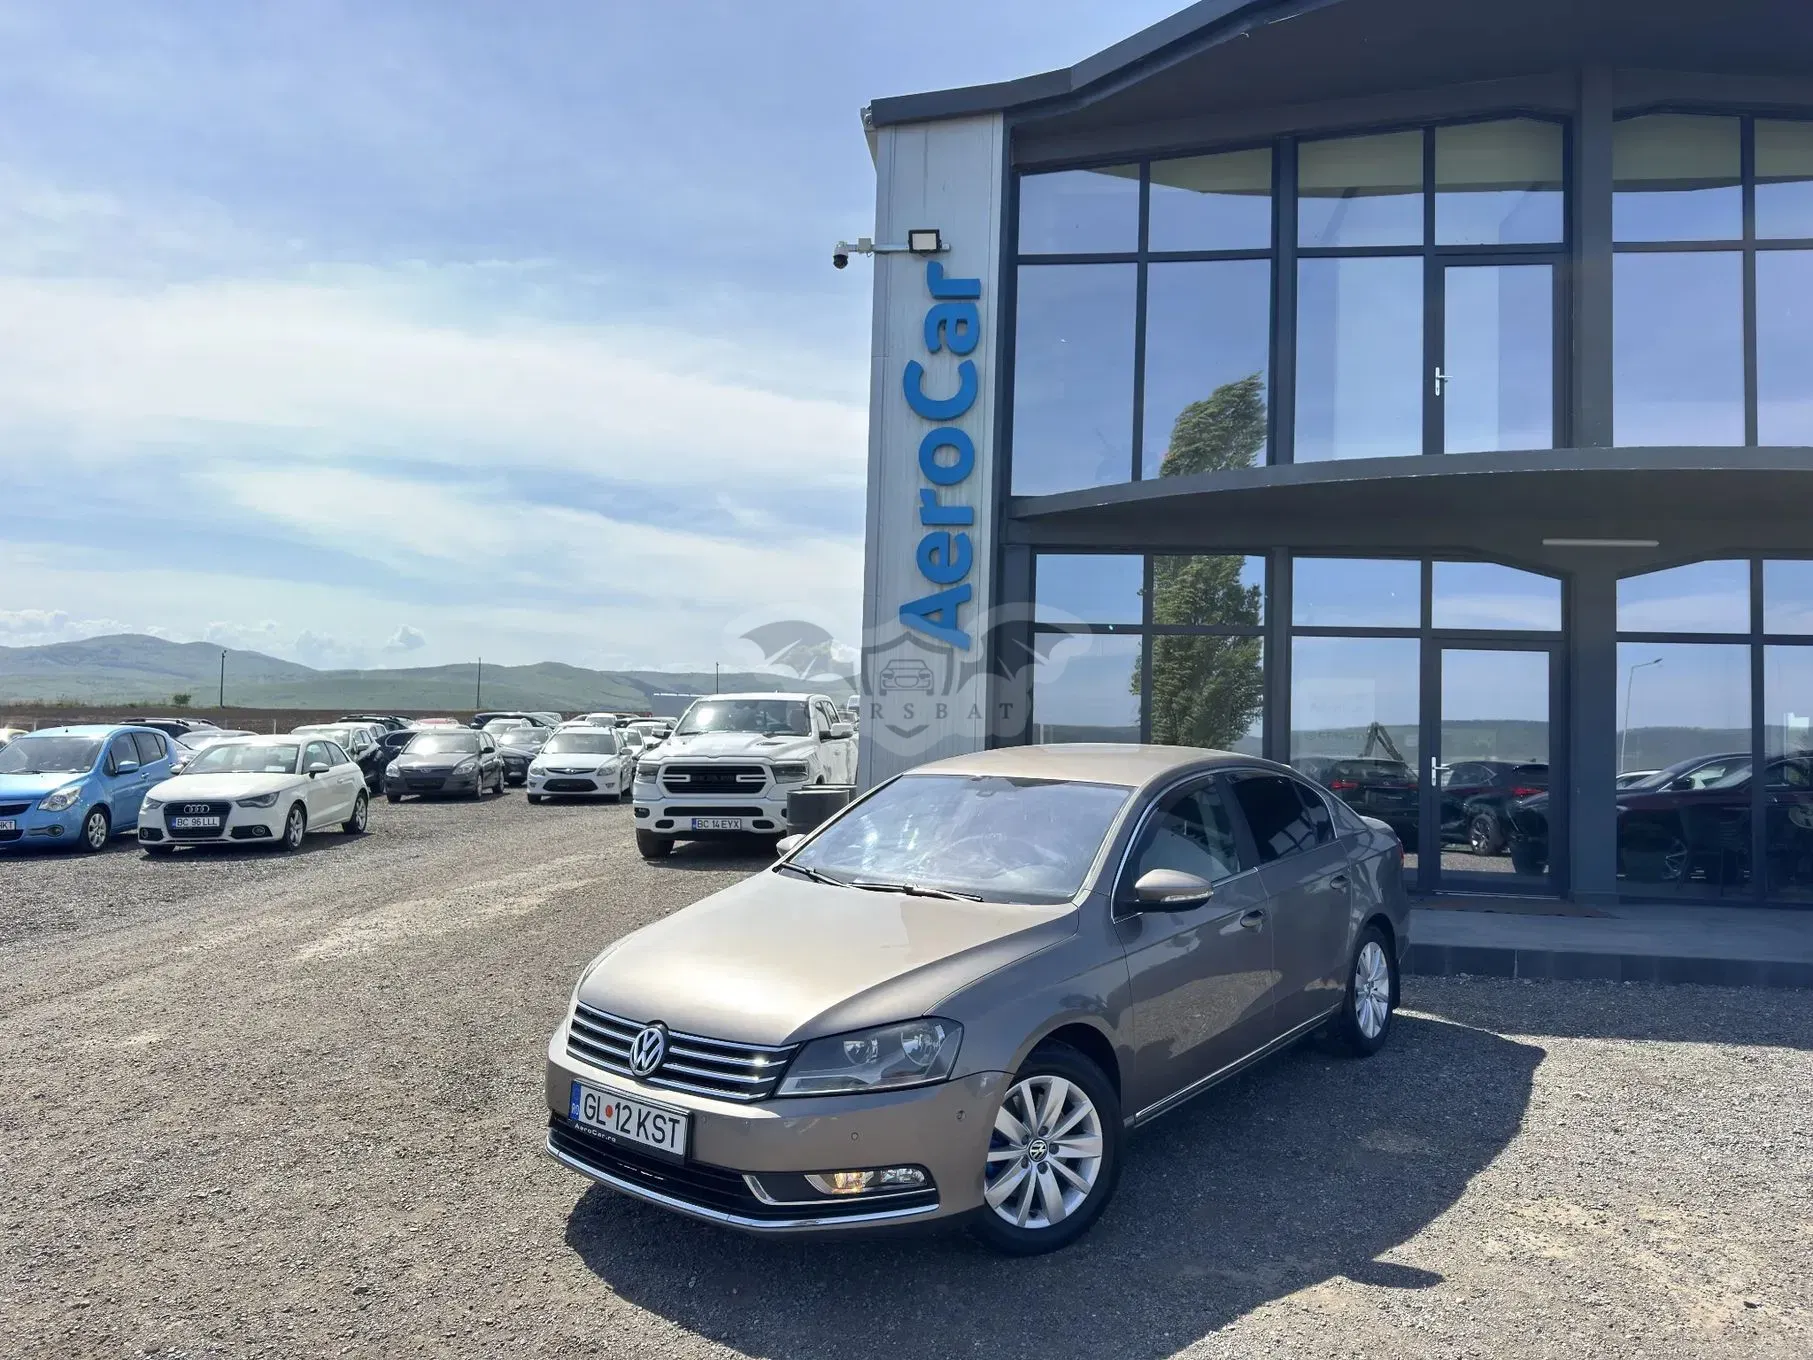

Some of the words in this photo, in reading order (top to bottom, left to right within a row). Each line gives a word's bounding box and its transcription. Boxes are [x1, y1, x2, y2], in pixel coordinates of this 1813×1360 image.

[899, 260, 982, 652] AeroCar
[177, 818, 189, 826] BC
[191, 818, 202, 826] 96
[203, 817, 217, 826] LLL
[697, 819, 709, 829] BC
[711, 819, 720, 829] 14
[721, 819, 740, 829] EYX
[584, 1093, 606, 1126] GL
[614, 1101, 633, 1135] 12
[636, 1108, 681, 1149] KST
[574, 1122, 617, 1143] AeroCar.ro
